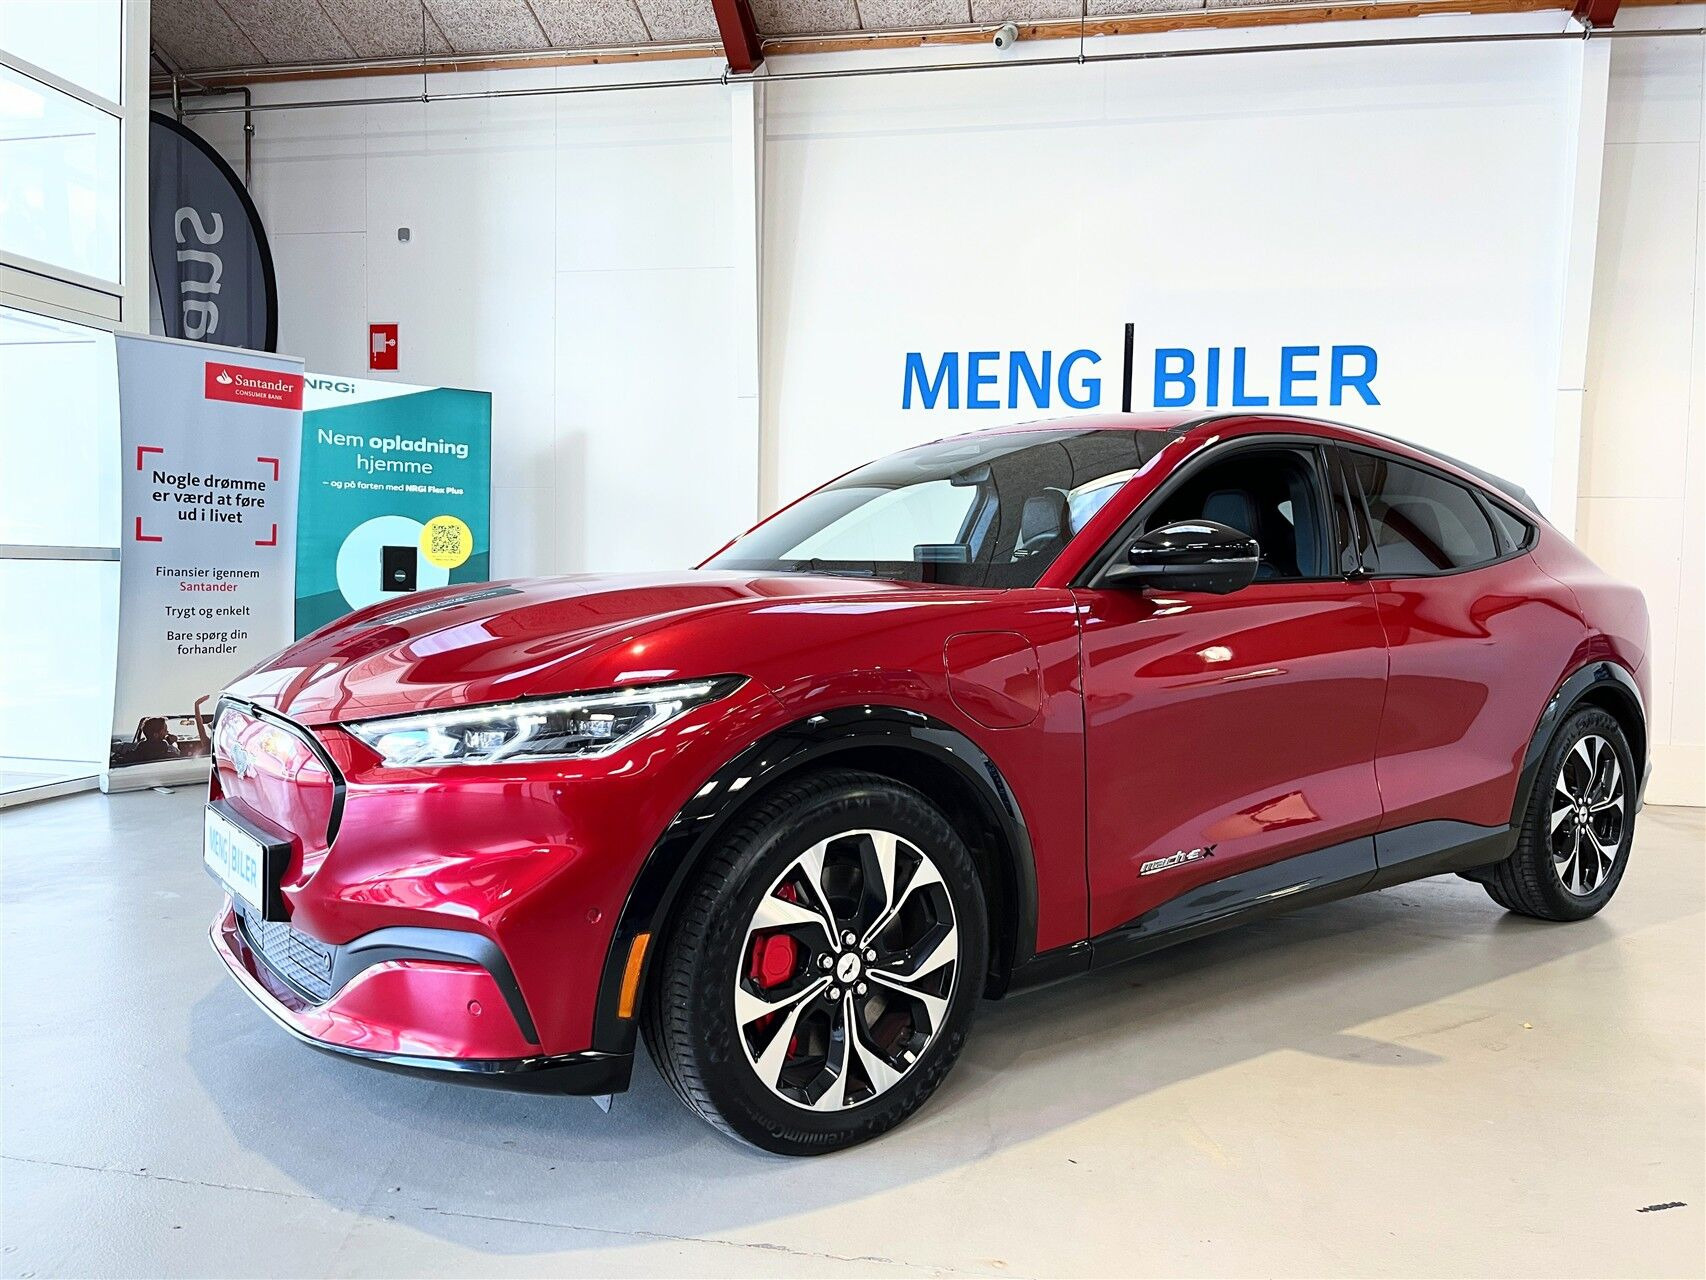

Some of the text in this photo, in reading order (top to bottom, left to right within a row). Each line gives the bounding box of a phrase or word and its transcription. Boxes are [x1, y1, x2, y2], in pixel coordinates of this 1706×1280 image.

[235, 374, 294, 393] Santander
[901, 345, 1382, 410] MENG BILER
[235, 389, 283, 401] CONSUMER BANK
[318, 428, 469, 459] Nem opladning
[357, 453, 433, 474] hjemme
[152, 470, 266, 492] Nogle drømme
[330, 481, 343, 490] og
[344, 480, 356, 490] på
[385, 484, 404, 492] med
[428, 486, 446, 494] Flex
[446, 487, 465, 495] Plus
[152, 491, 265, 508] er værd at føre
[178, 508, 243, 523] ud i livet
[156, 566, 260, 580] Finansier igennem
[180, 581, 239, 592] Santander
[165, 605, 250, 618] Trygt og enkelt
[167, 630, 248, 643] Bare spørg din
[177, 644, 238, 655] forhandler
[231, 844, 257, 889] BILER
